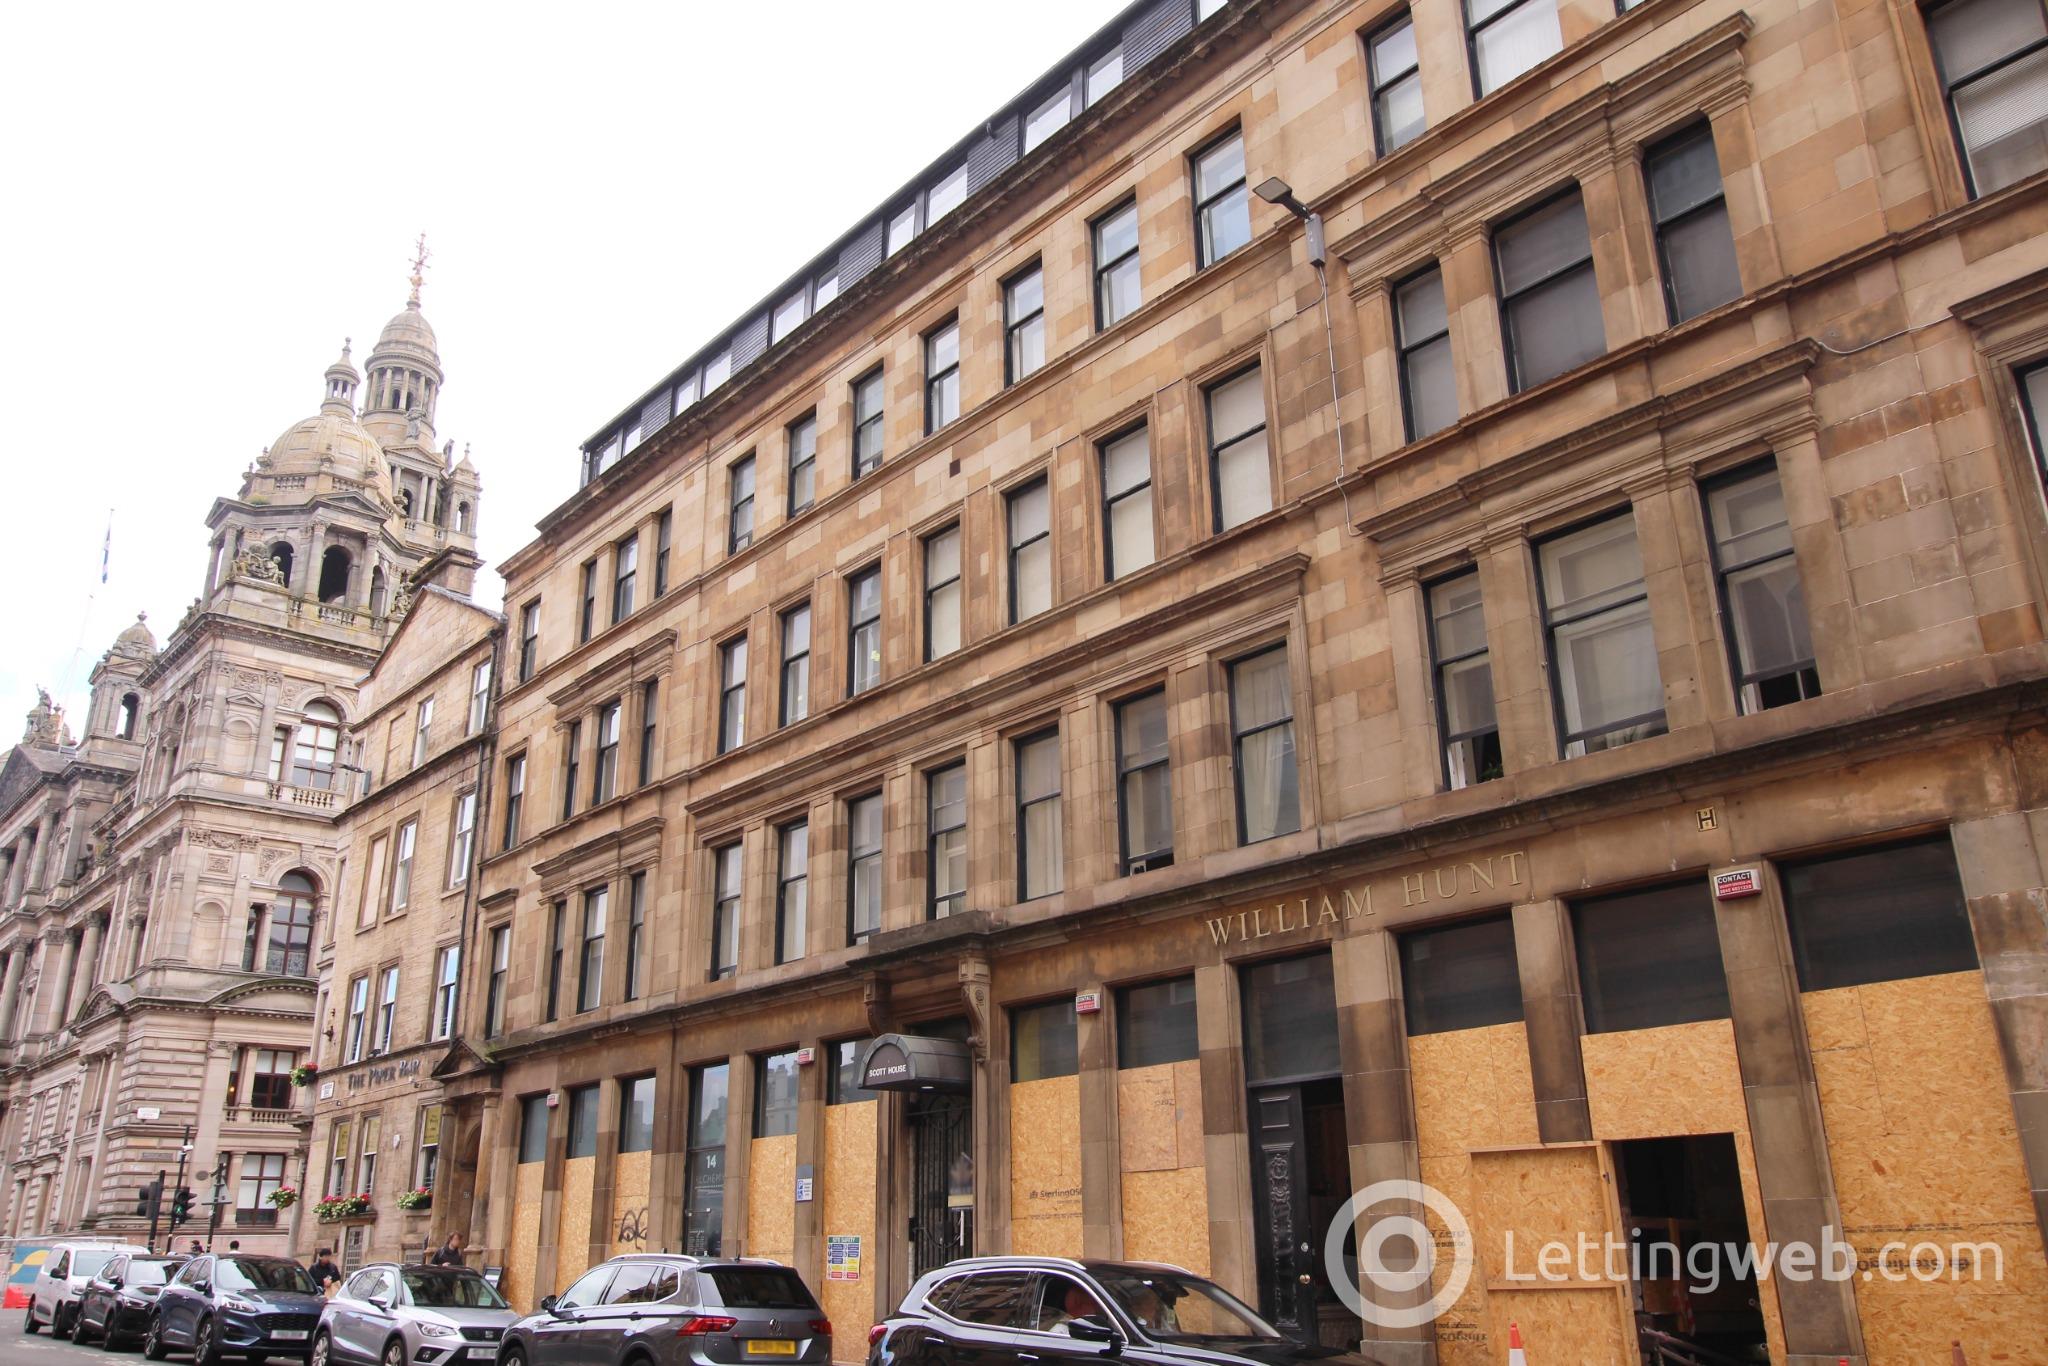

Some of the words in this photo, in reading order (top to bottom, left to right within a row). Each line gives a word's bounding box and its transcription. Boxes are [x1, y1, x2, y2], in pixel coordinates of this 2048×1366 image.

[1718, 872, 1751, 884] CONTACT
[1206, 885, 1376, 946] WILLIAM
[1401, 851, 1524, 907] HUNT
[869, 1068, 886, 1078] SCOTT
[888, 1065, 907, 1075] HOUSE
[706, 1155, 717, 1169] 14
